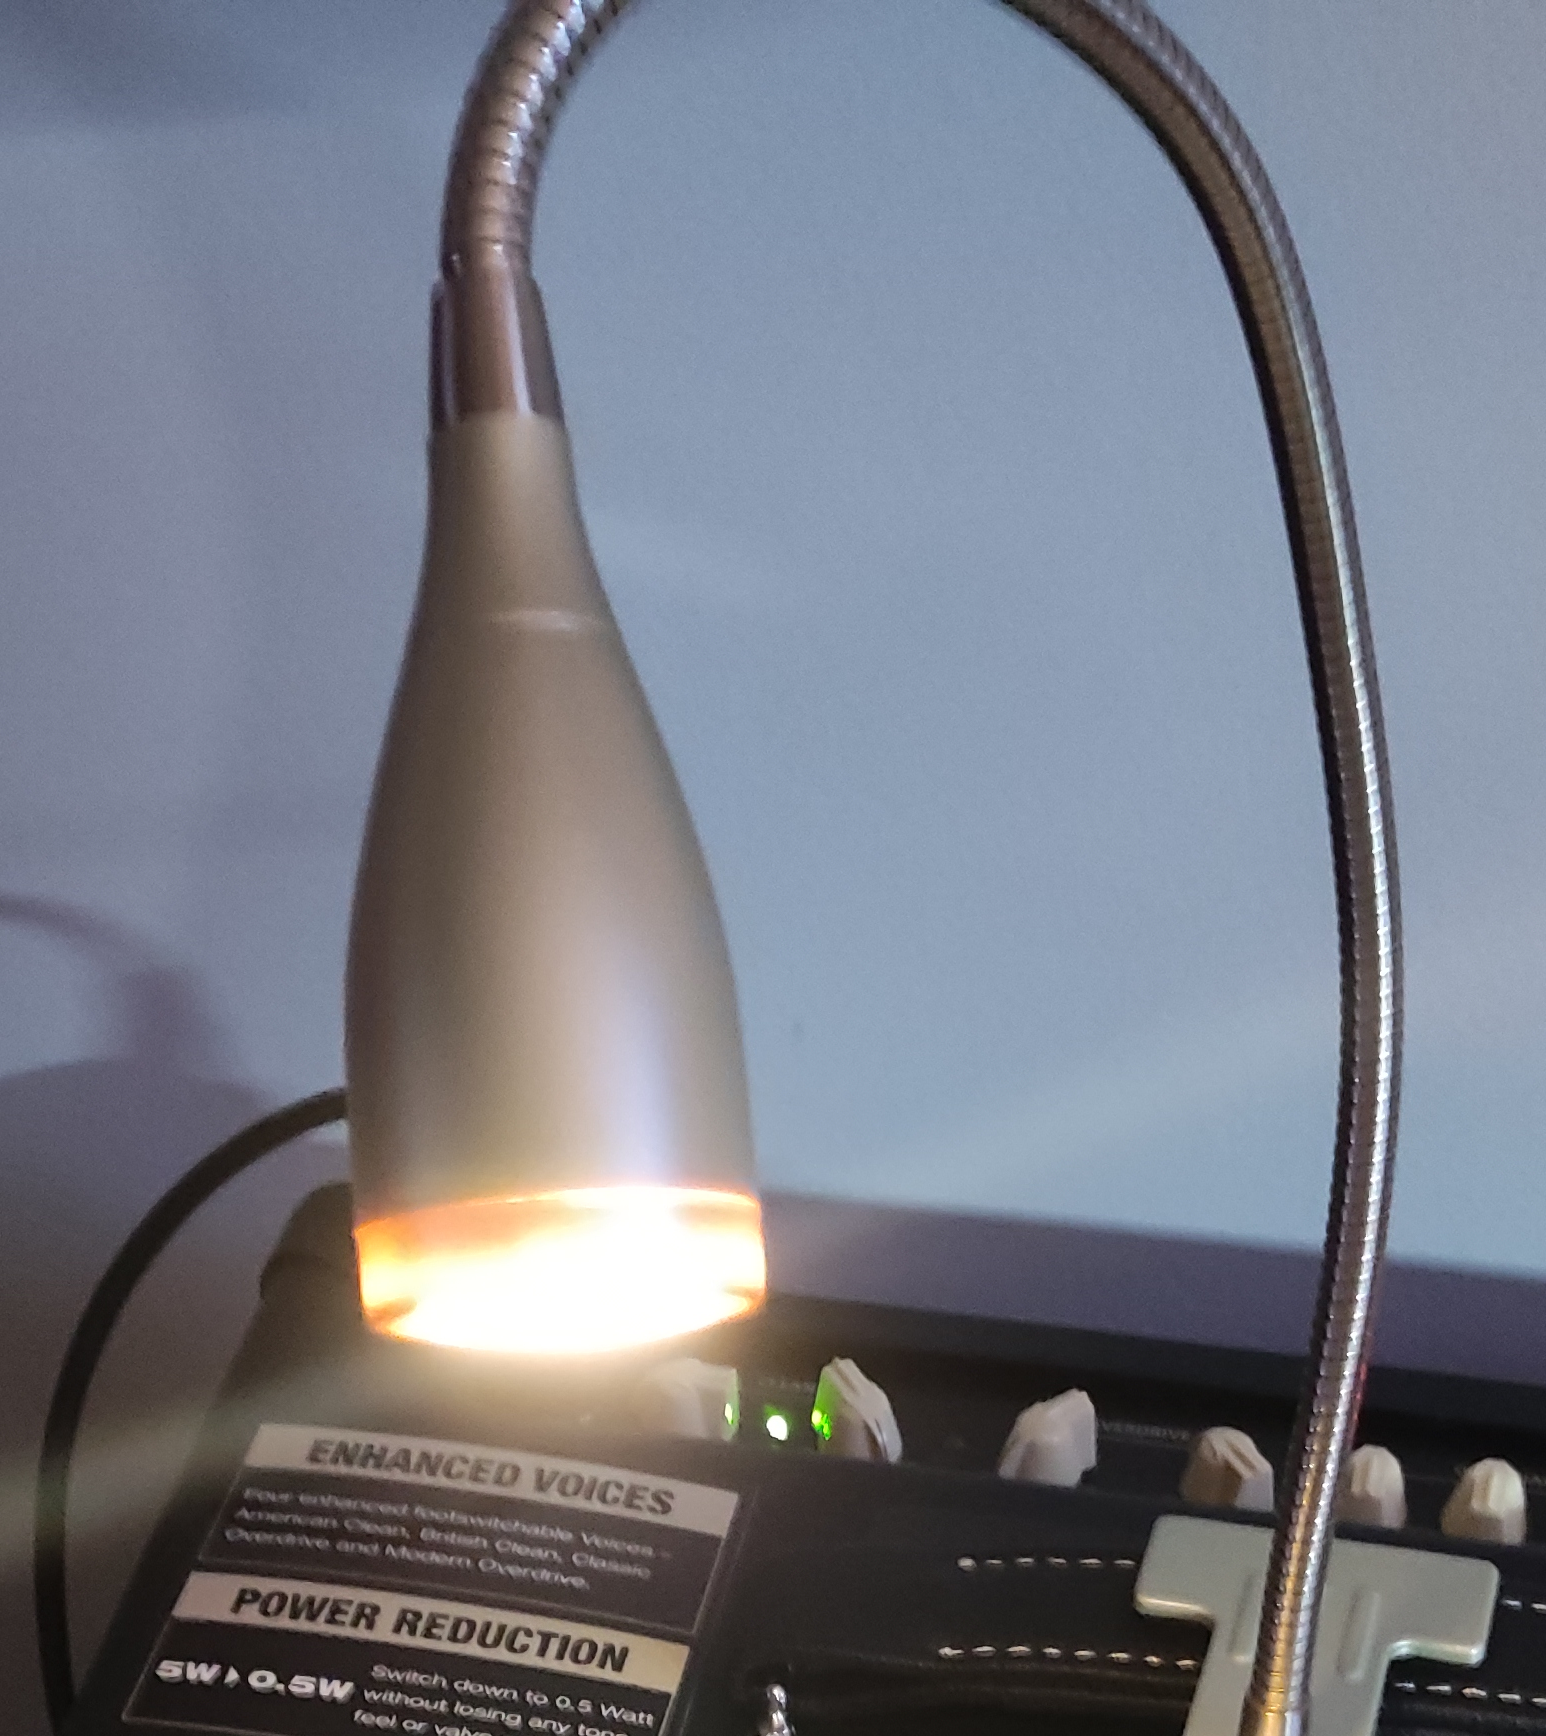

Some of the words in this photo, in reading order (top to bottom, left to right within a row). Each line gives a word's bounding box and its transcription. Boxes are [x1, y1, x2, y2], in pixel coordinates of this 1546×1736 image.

[306, 1439, 521, 1487] ENHANCED
[534, 1466, 675, 1516] VOICES
[230, 1587, 382, 1631] POWER
[392, 1607, 630, 1673] REDUCTION
[353, 1708, 398, 1730] feel
[402, 1717, 429, 1735] or
[362, 1687, 450, 1715] without
[453, 1700, 523, 1730] losing
[528, 1715, 572, 1736] any
[370, 1663, 449, 1691] Switch
[453, 1677, 520, 1702] down
[525, 1688, 550, 1706] to
[555, 1694, 594, 1714] 0.5
[600, 1701, 655, 1728] Watt
